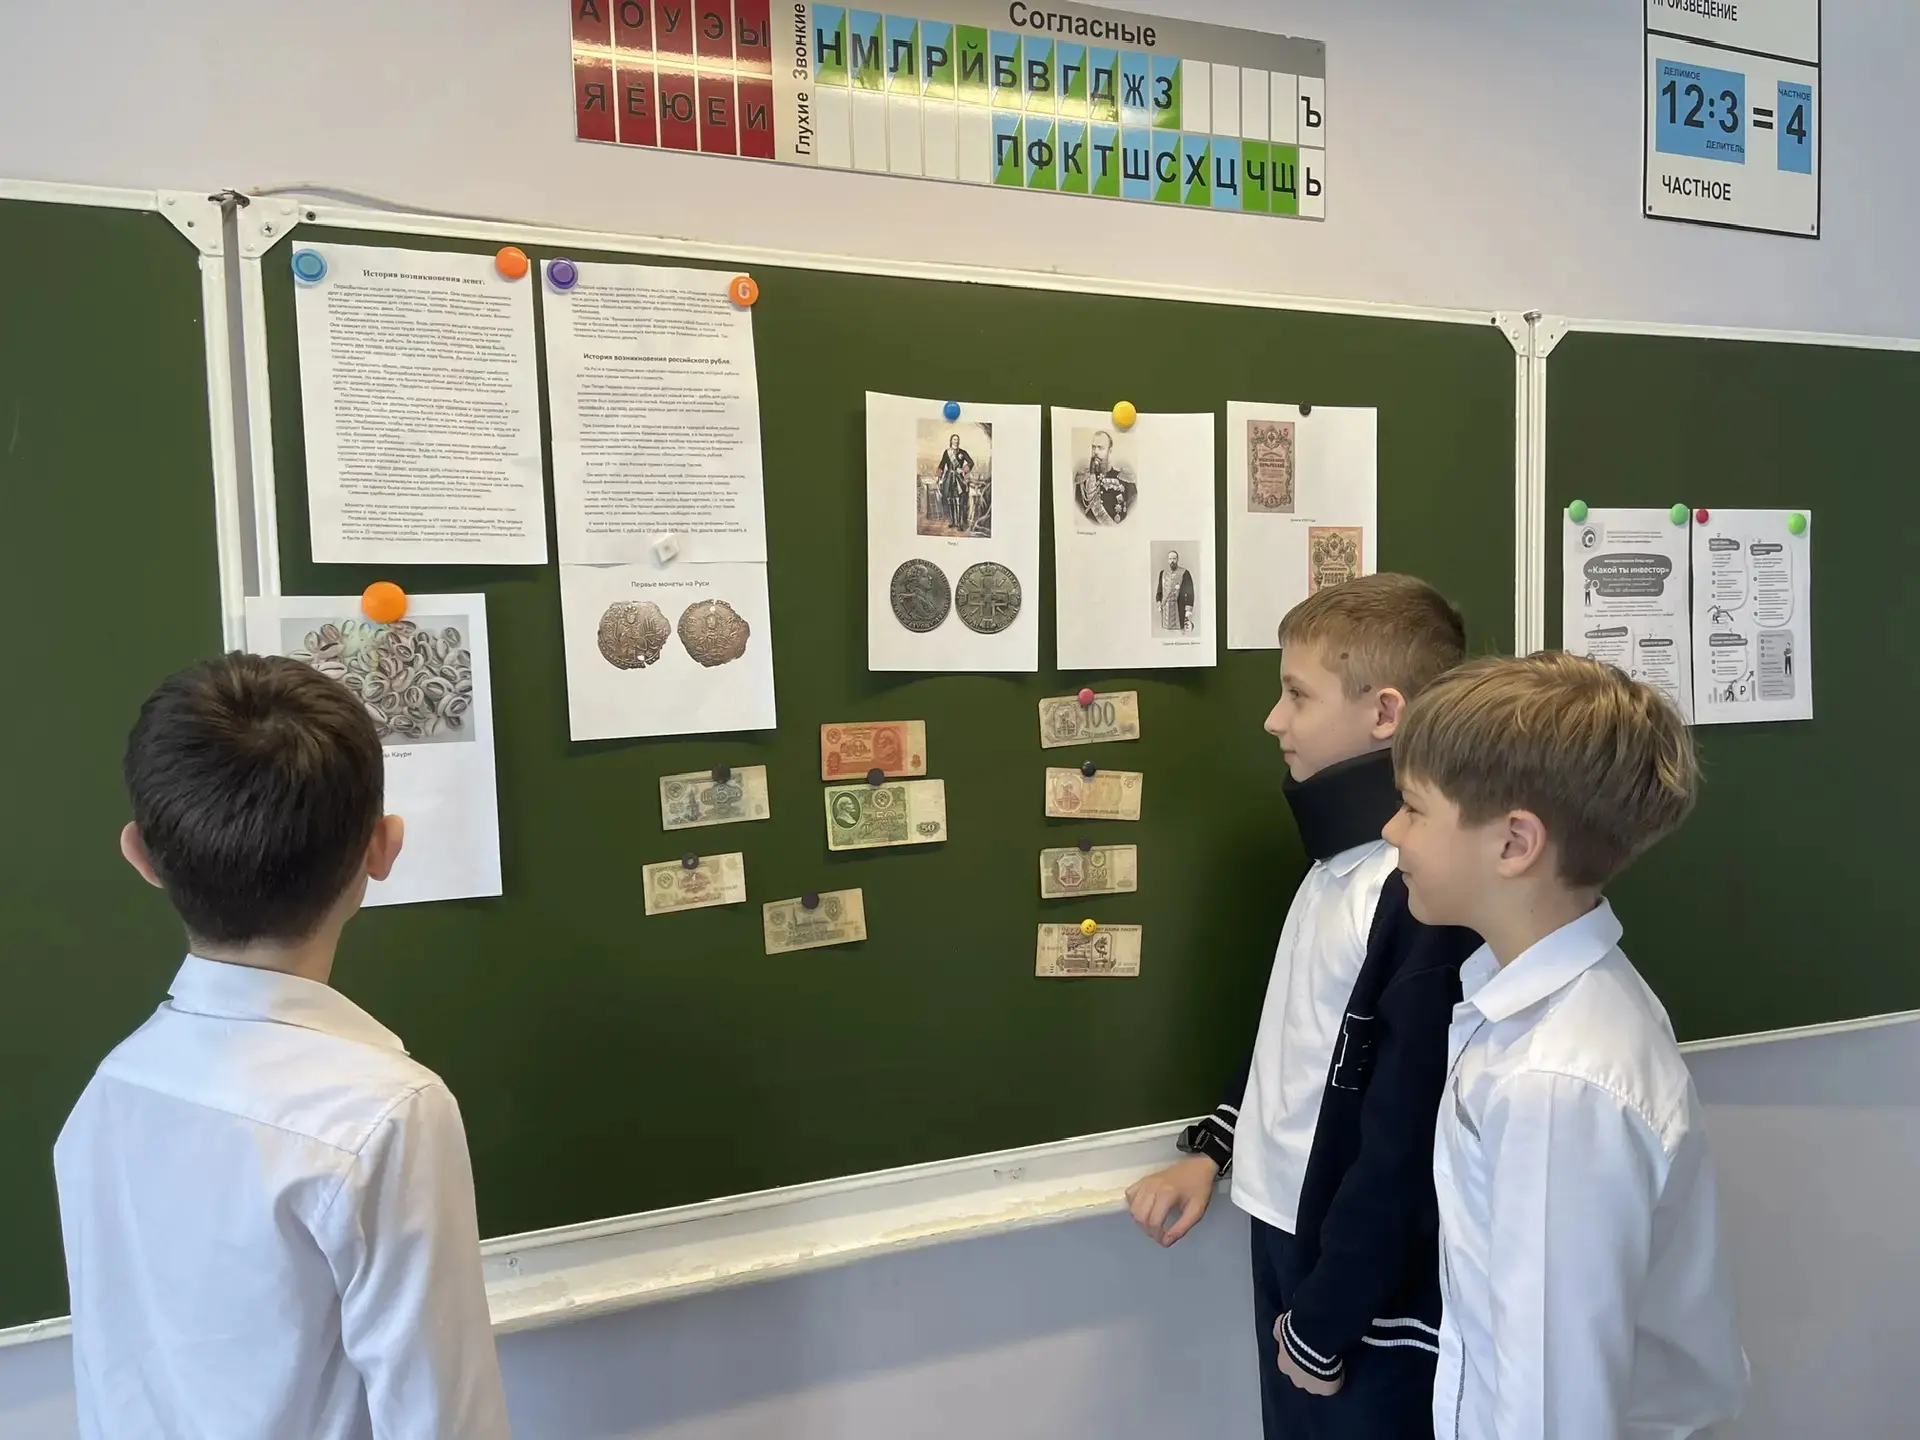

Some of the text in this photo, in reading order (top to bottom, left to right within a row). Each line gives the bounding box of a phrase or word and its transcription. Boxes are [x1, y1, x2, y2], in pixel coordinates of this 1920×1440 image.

[578, 0, 768, 48] А О У Э Ы
[1009, 0, 1157, 47] Согласные
[1653, 0, 1738, 22] ОИЗВЕДЕНИЕ
[793, 3, 808, 81] Звонкие
[816, 28, 1322, 128] Н М Л Р Й Б В Г Д Ж З Ъ
[1664, 66, 1701, 81] ДЕЛИМОЕ
[584, 82, 767, 130] Я Ё Ю Е И
[1778, 88, 1812, 101] ЧАСТНОЕ
[796, 91, 814, 156] Глухие
[1786, 104, 1807, 145] 4
[1705, 139, 1745, 154] ДЕЛИТЕЛЬ
[996, 134, 1322, 200] П Ф К Т Ш С Х Ц Ч Щ Ь
[1662, 174, 1732, 202] ЧАСТНОЕ
[362, 269, 398, 280] История
[400, 272, 460, 283] возникновения
[583, 353, 612, 361] История
[668, 356, 709, 364] российского
[1588, 565, 1618, 574] «Какой
[1630, 567, 1670, 575] инвестор»
[694, 580, 710, 588] Руси
[1083, 701, 1116, 728] 100
